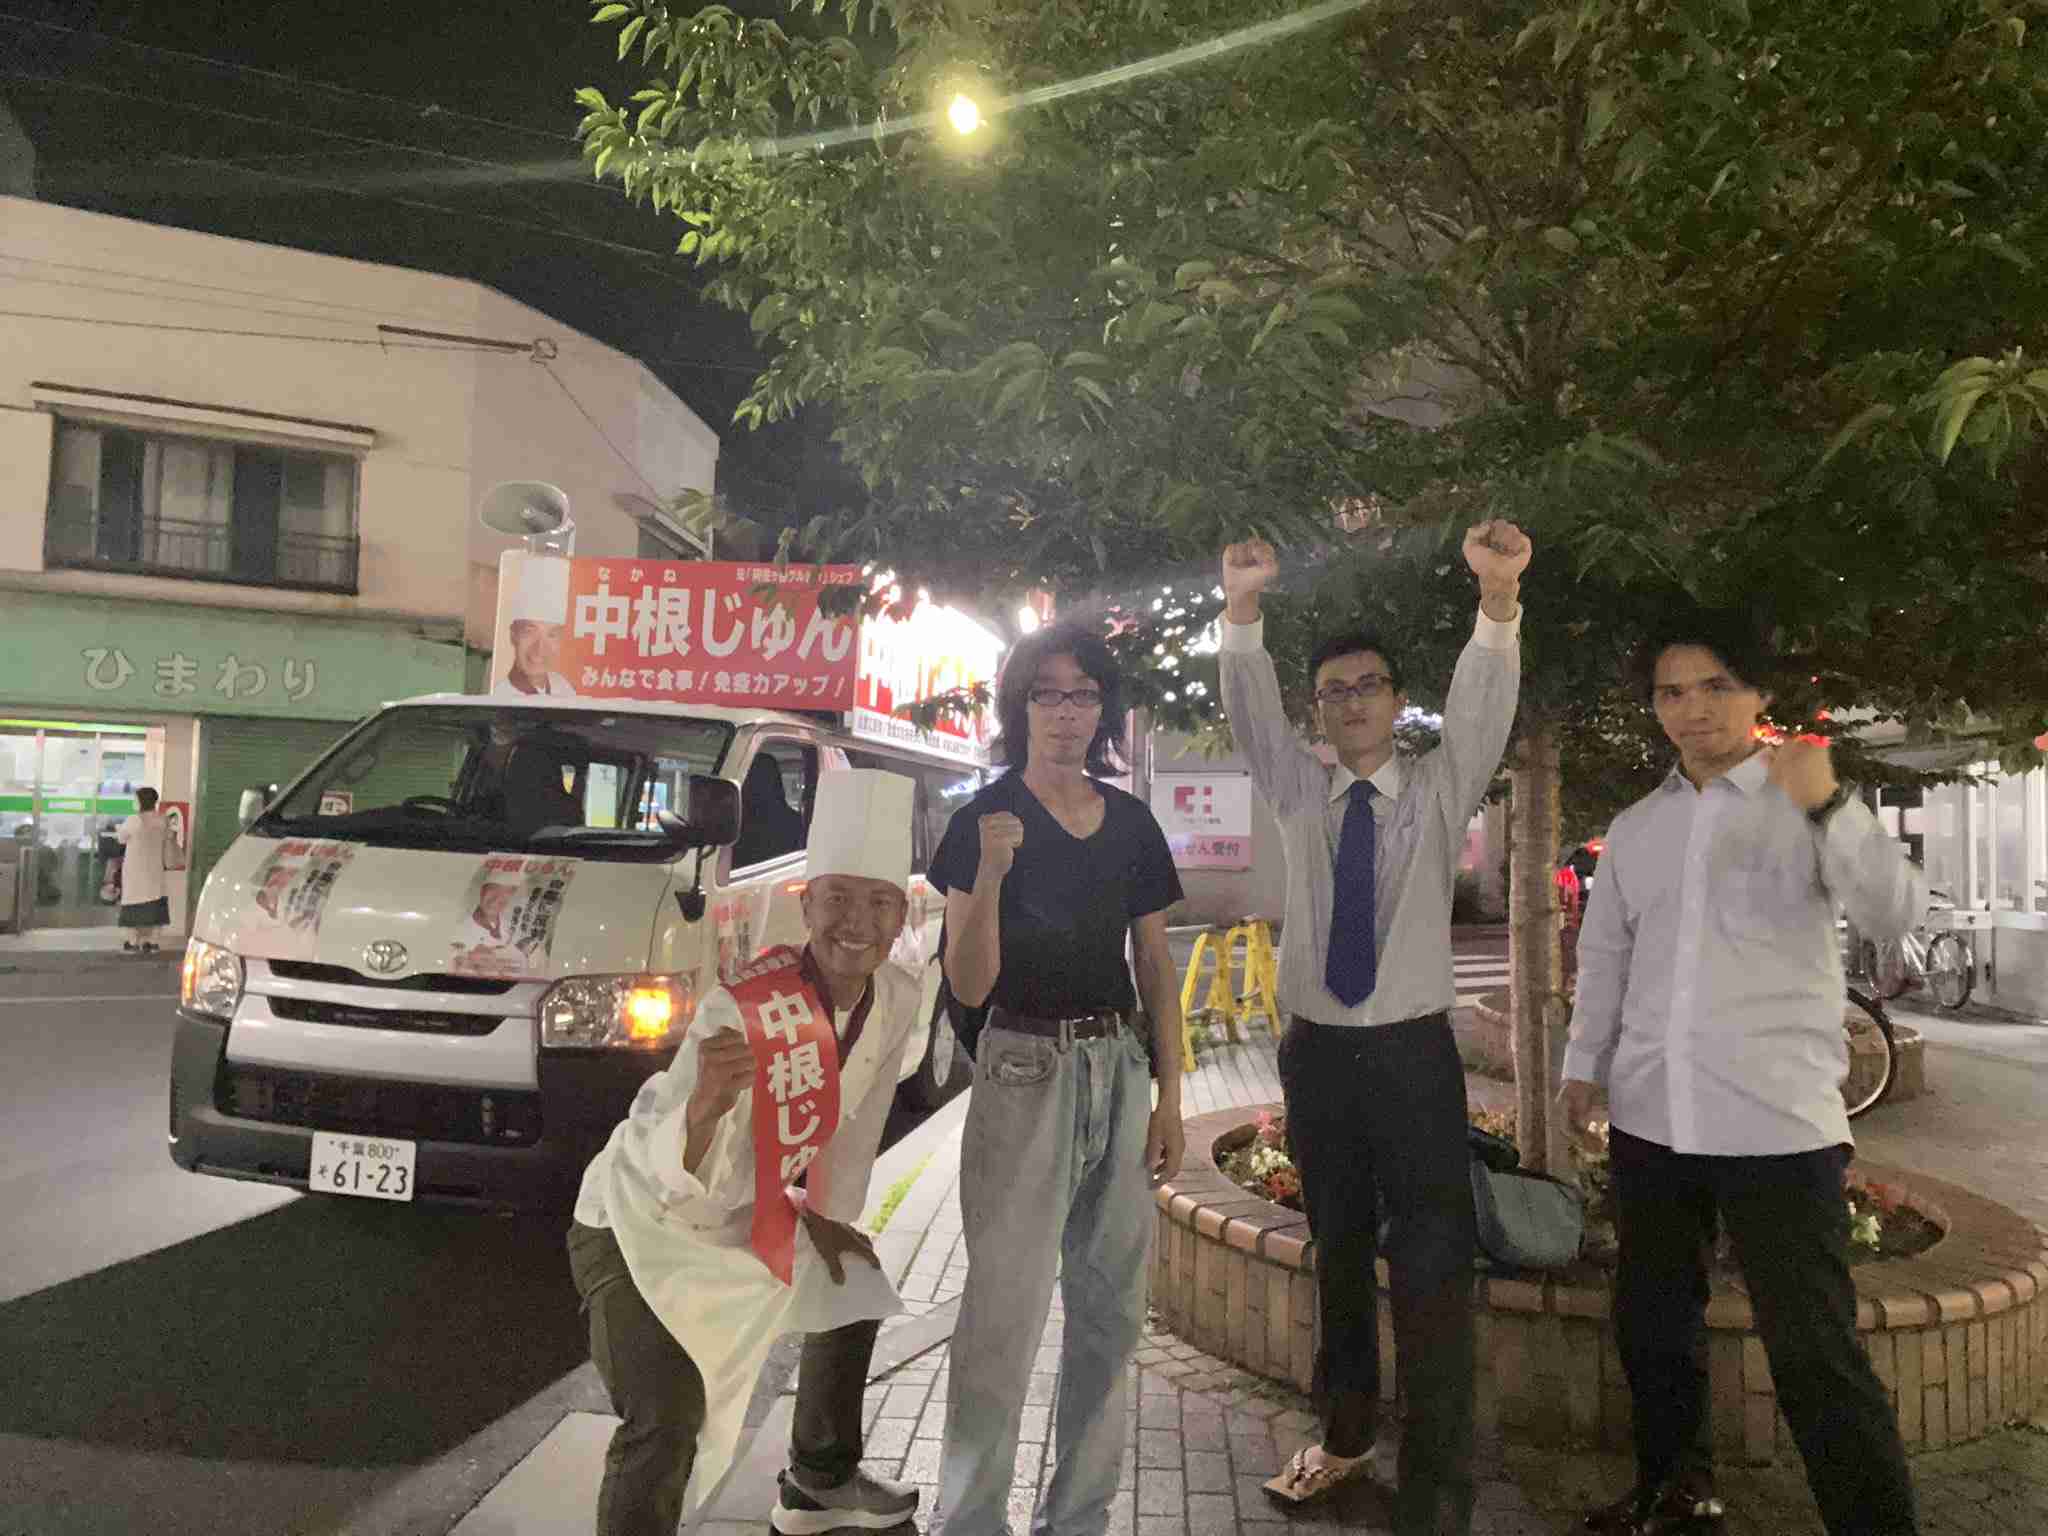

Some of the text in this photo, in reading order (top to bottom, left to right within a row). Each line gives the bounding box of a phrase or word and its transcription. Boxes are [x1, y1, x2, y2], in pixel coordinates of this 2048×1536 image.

[597, 566, 678, 583] なかね
[573, 583, 852, 663] 中根じゅん
[80, 647, 316, 703] ひまわり
[333, 1161, 408, 1194] 61-23
